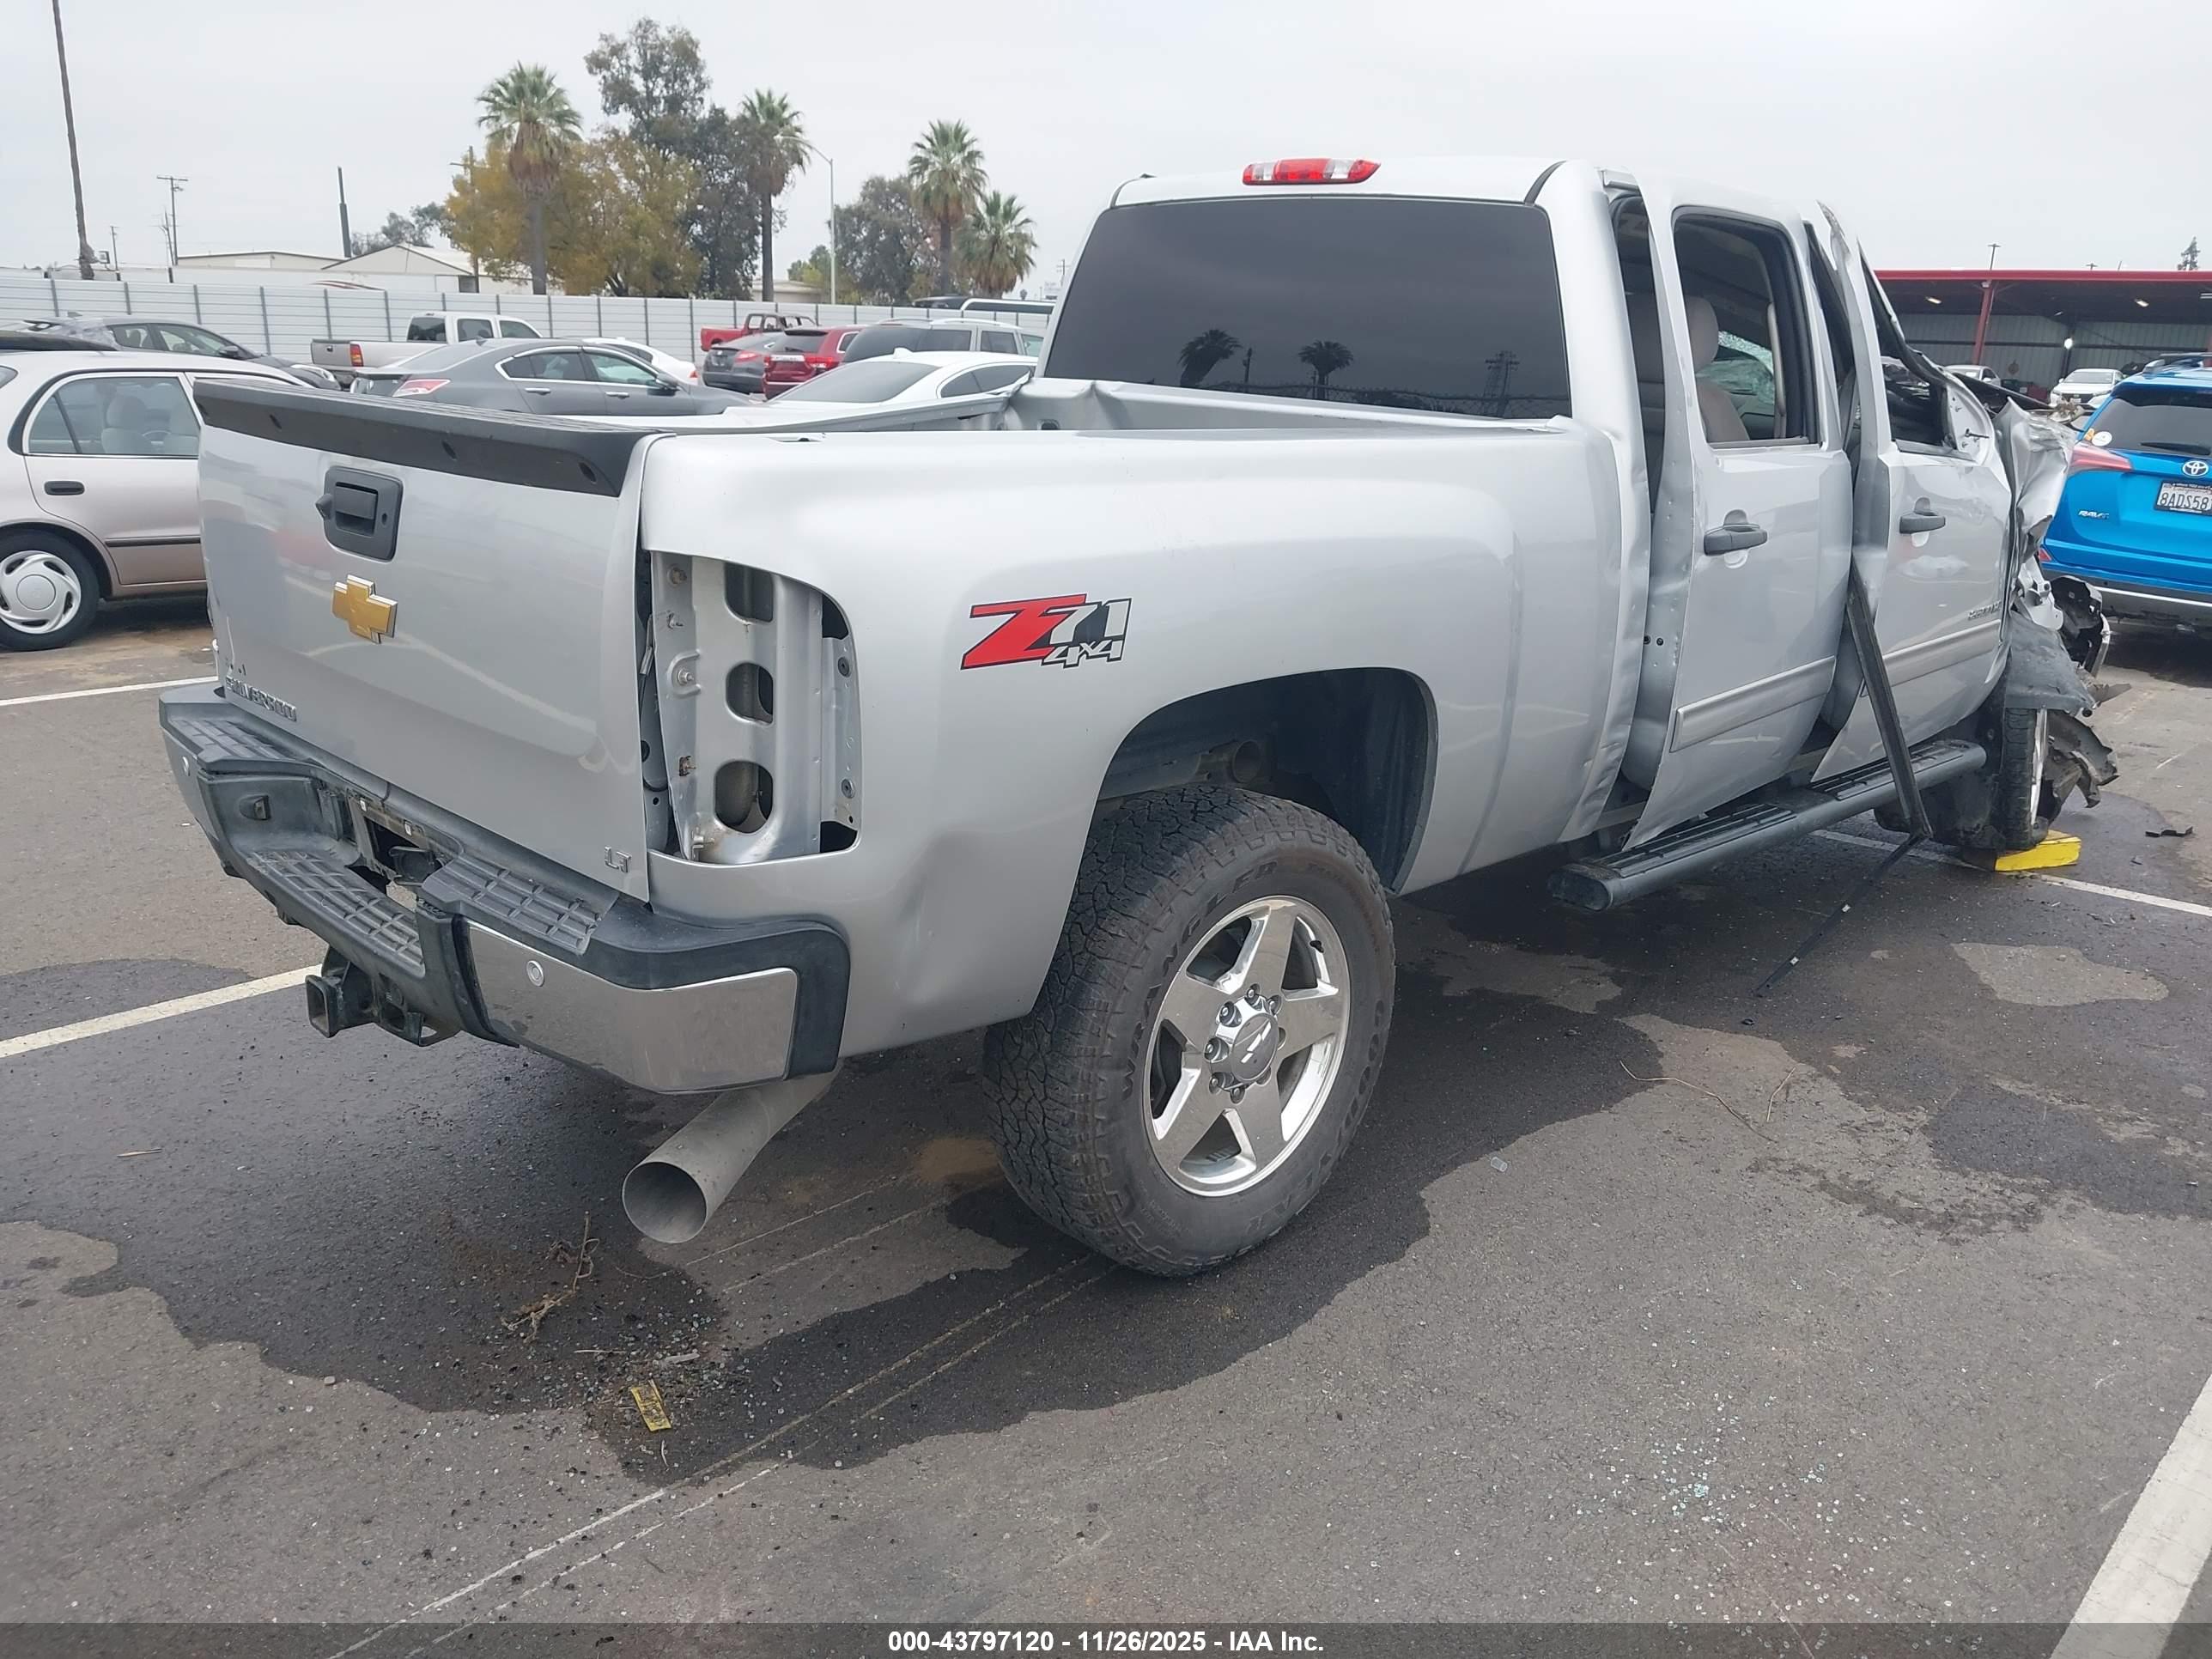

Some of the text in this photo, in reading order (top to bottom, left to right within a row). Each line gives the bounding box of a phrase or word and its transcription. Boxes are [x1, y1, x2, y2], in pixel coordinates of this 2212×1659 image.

[2160, 492, 2212, 511] 8ADS58
[960, 592, 1133, 670] Z71
[604, 846, 633, 873] LT
